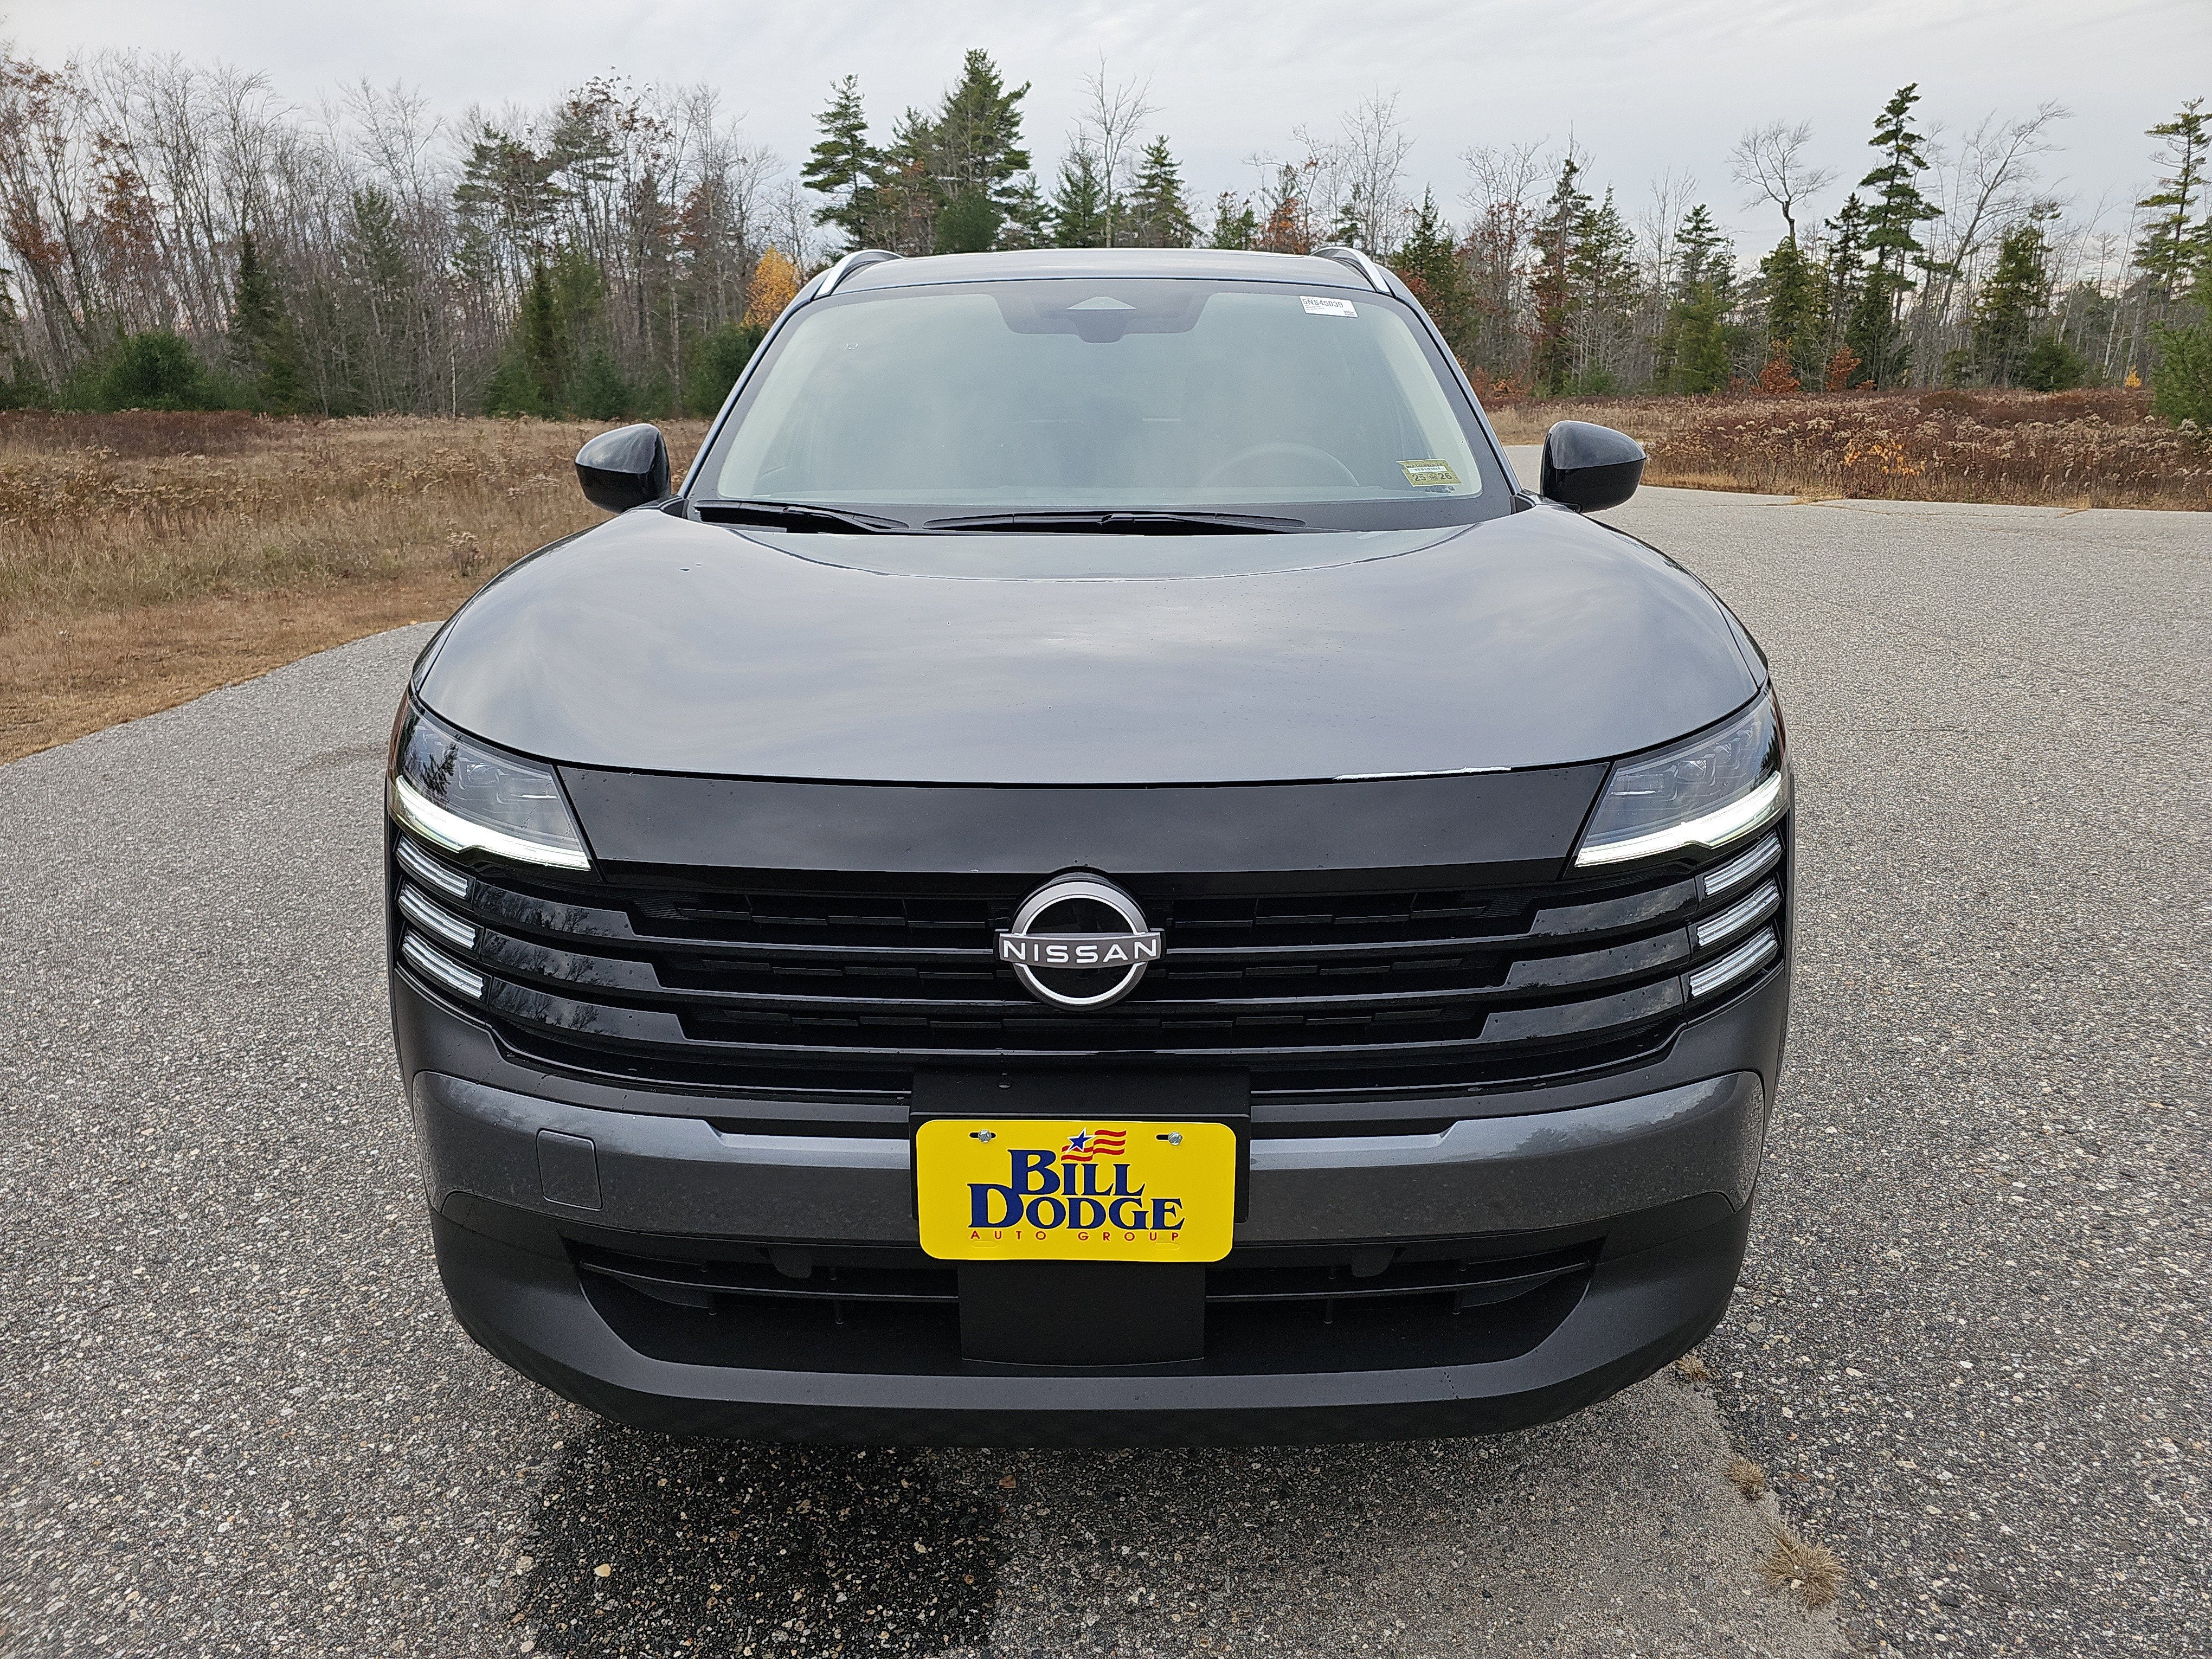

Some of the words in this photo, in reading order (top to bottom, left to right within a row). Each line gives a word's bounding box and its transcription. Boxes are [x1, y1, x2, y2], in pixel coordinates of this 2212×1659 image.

[1302, 299, 1343, 307] 5NS45039
[1003, 938, 1156, 963] NISSAN
[1008, 1149, 1145, 1197] BILL
[967, 1183, 1185, 1230] DODGE
[970, 1231, 1046, 1240] AUTO
[1078, 1231, 1179, 1242] GROUP
